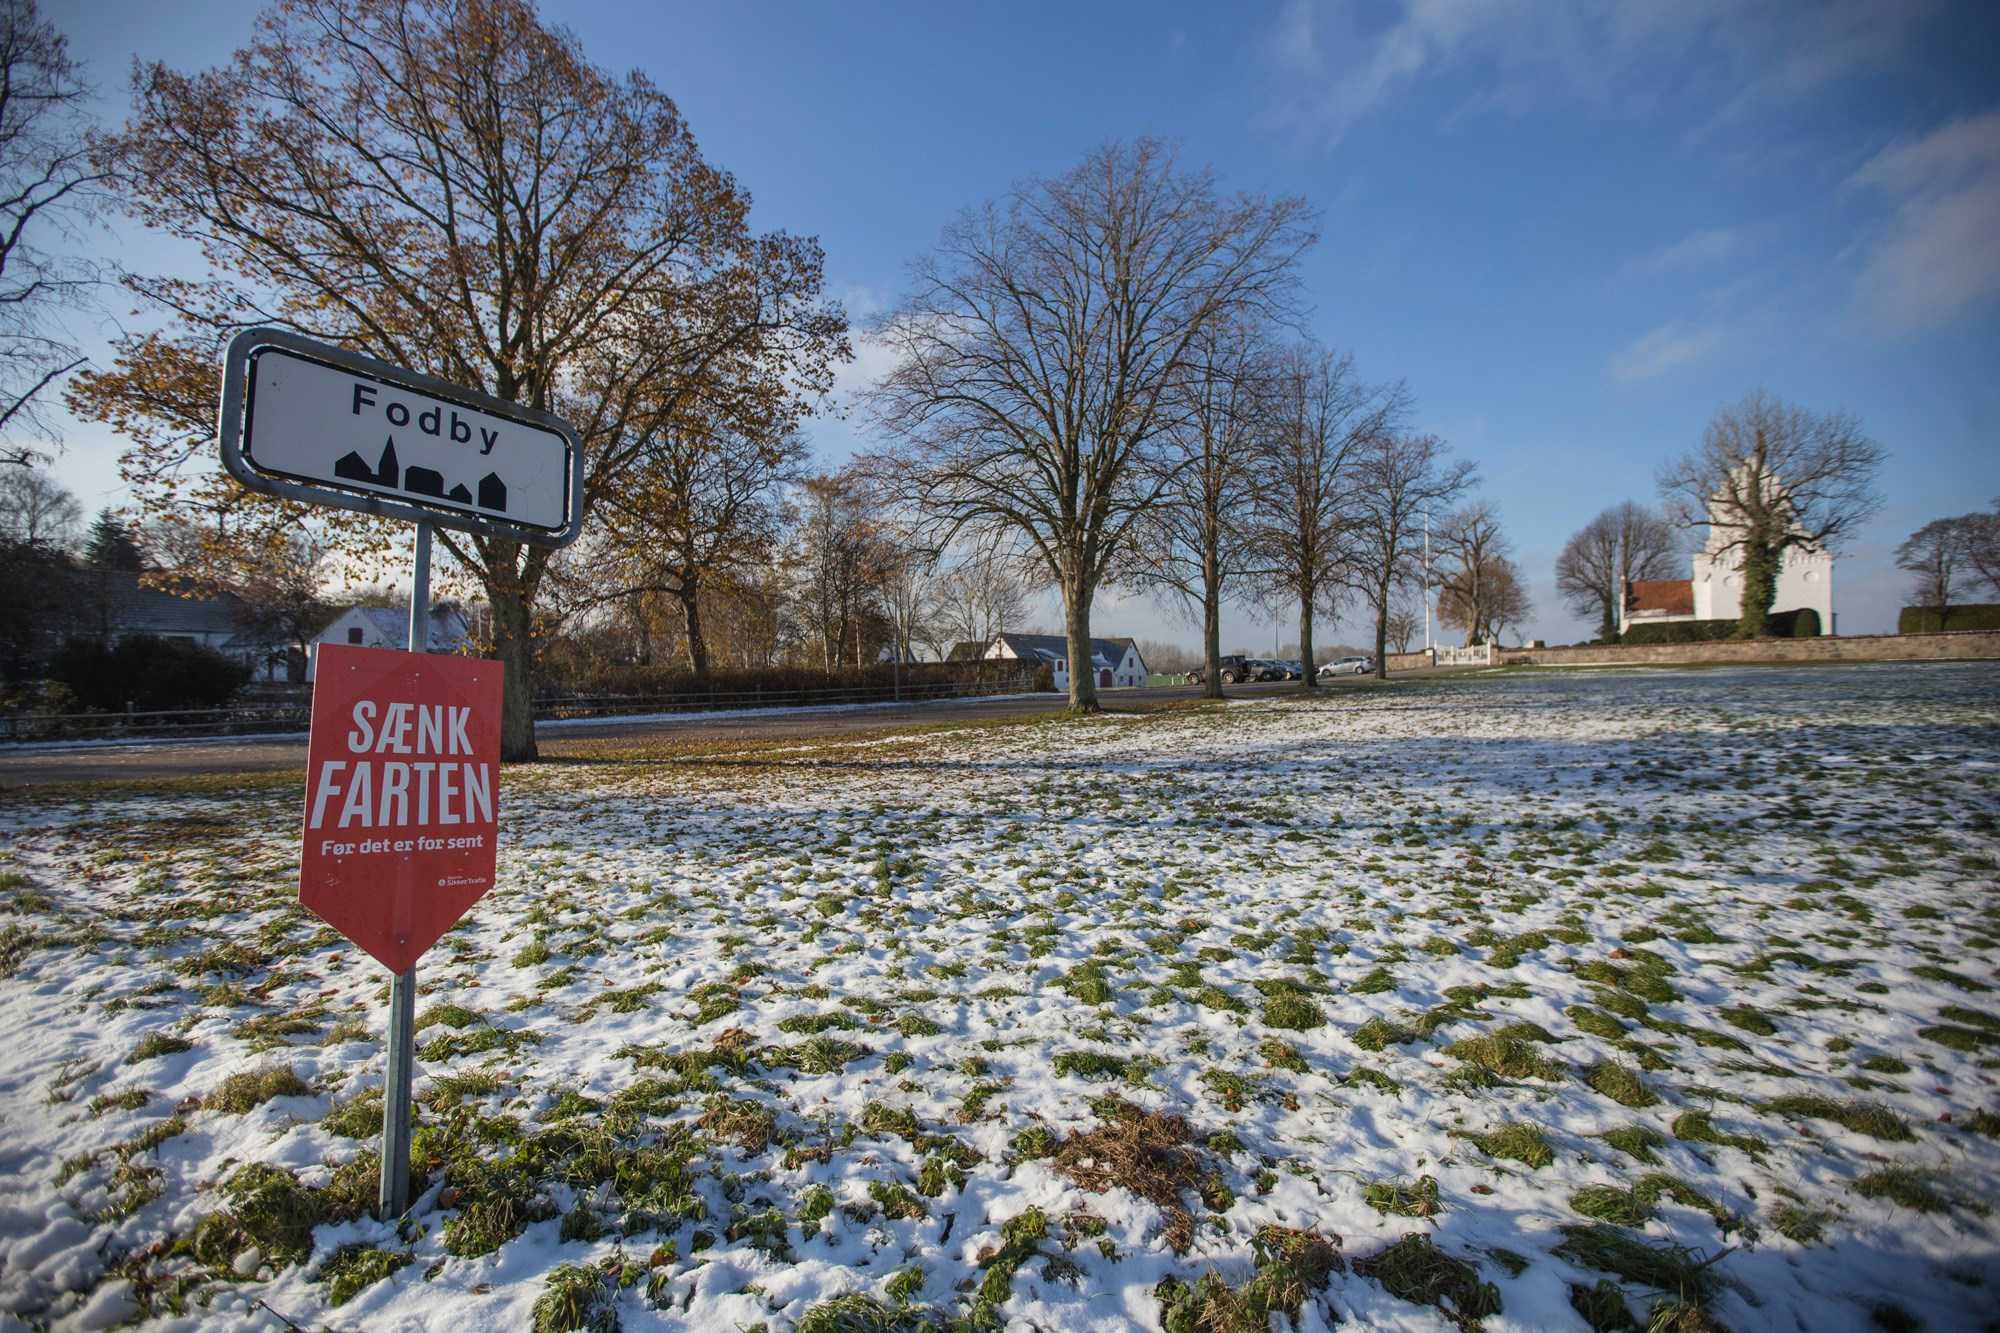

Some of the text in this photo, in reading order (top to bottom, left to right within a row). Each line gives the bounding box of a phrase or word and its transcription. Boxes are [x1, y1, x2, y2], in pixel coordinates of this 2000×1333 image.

[352, 383, 499, 455] Fodby
[348, 701, 474, 755] SÆNK
[309, 761, 493, 829] FARTEN
[321, 834, 483, 856] Før det er for sent
